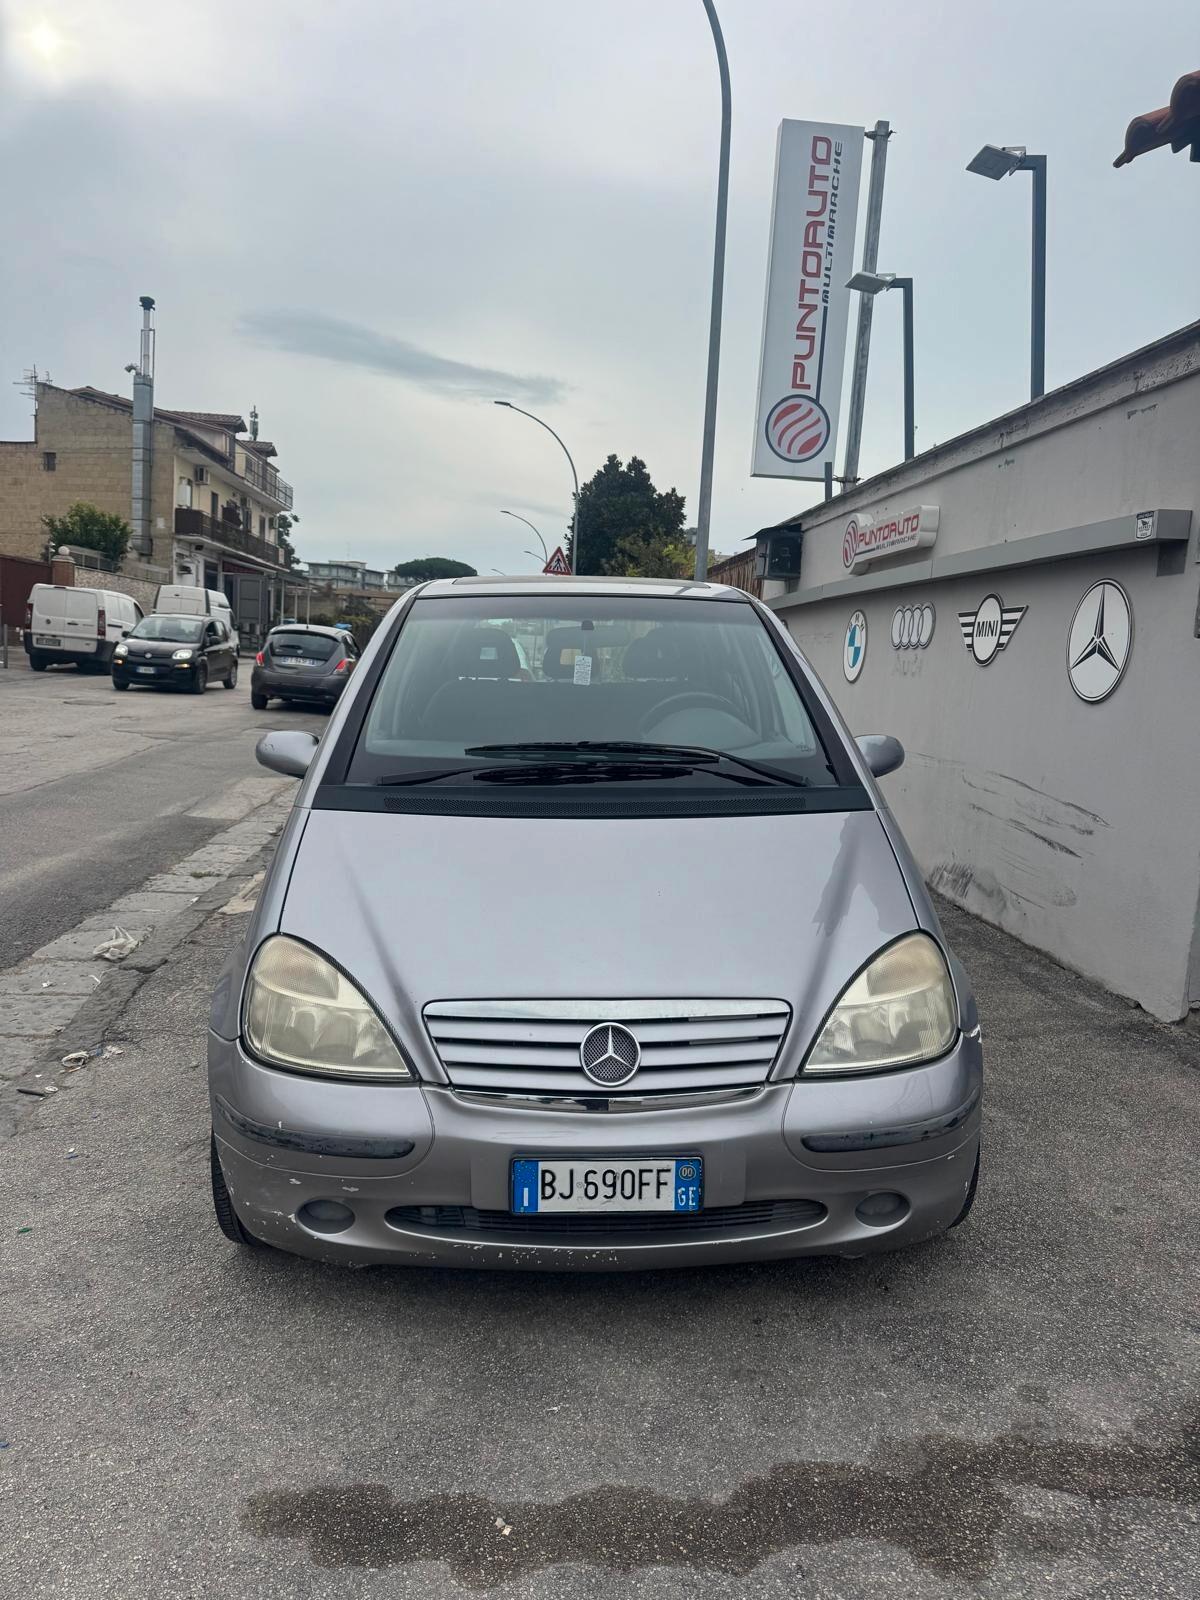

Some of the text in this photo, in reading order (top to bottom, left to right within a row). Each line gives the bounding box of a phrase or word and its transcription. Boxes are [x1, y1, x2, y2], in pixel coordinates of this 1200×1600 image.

[821, 141, 843, 304] MULTIMARCHE
[791, 135, 832, 390] PUNTOAUTO
[857, 513, 920, 549] PUNTOAUTO
[975, 619, 999, 638] MINI
[677, 1186, 697, 1206] GE
